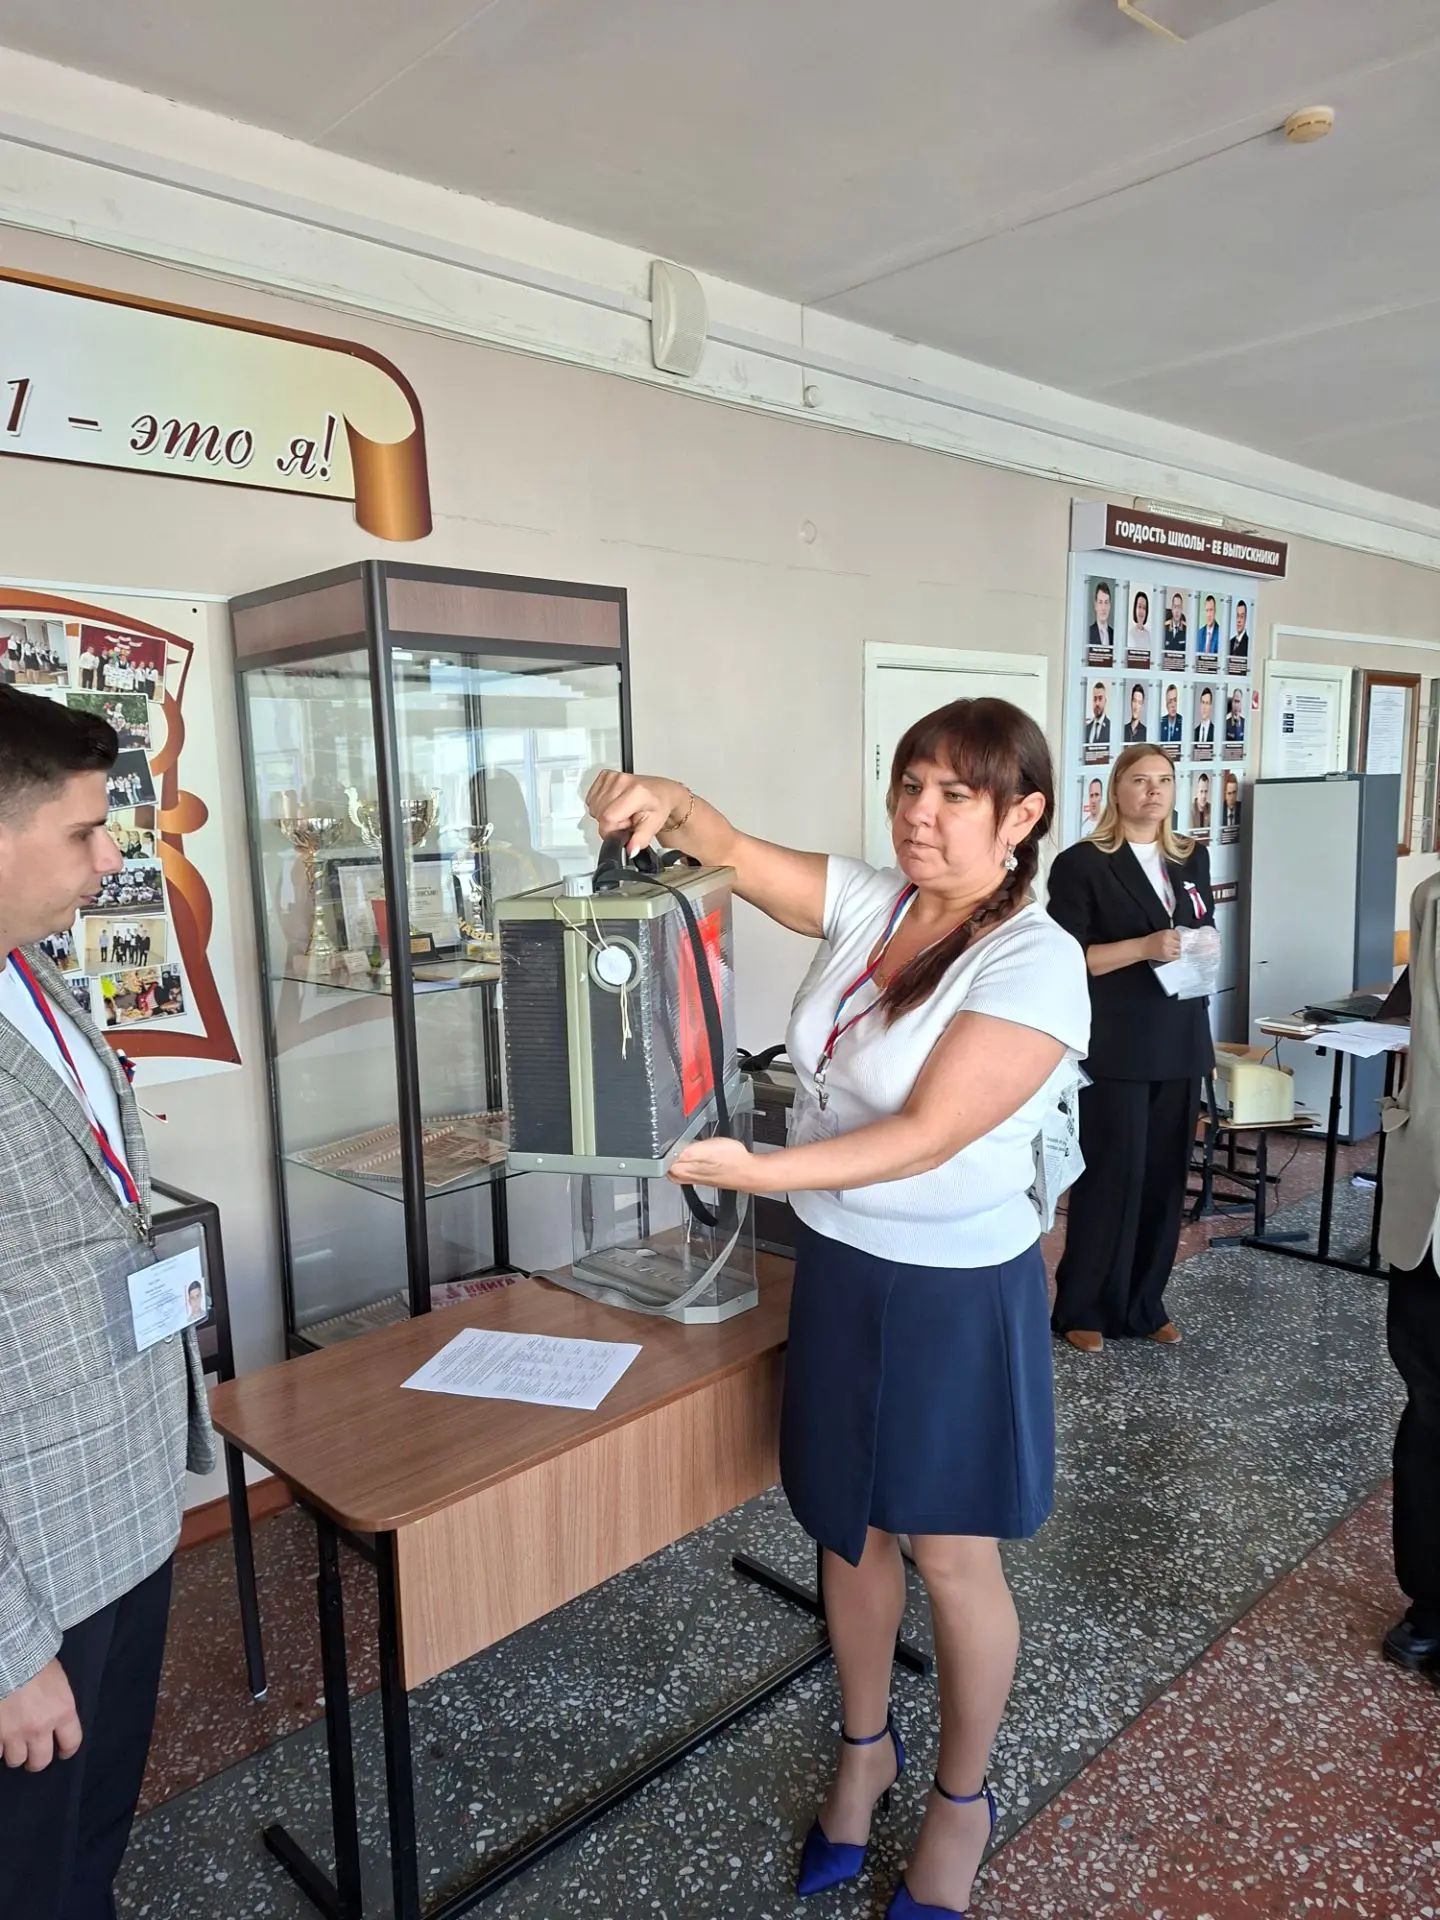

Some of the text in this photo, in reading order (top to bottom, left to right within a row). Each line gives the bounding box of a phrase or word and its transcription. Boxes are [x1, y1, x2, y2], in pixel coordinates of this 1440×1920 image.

[129, 414, 252, 466] это
[276, 414, 336, 478] я!
[1115, 519, 1166, 544] ГОРДОСТЬ
[1167, 530, 1205, 552] ШКОЛЫ
[1212, 540, 1222, 555] ЕЕ
[1222, 541, 1280, 566] ВЫПУСКНИКИ
